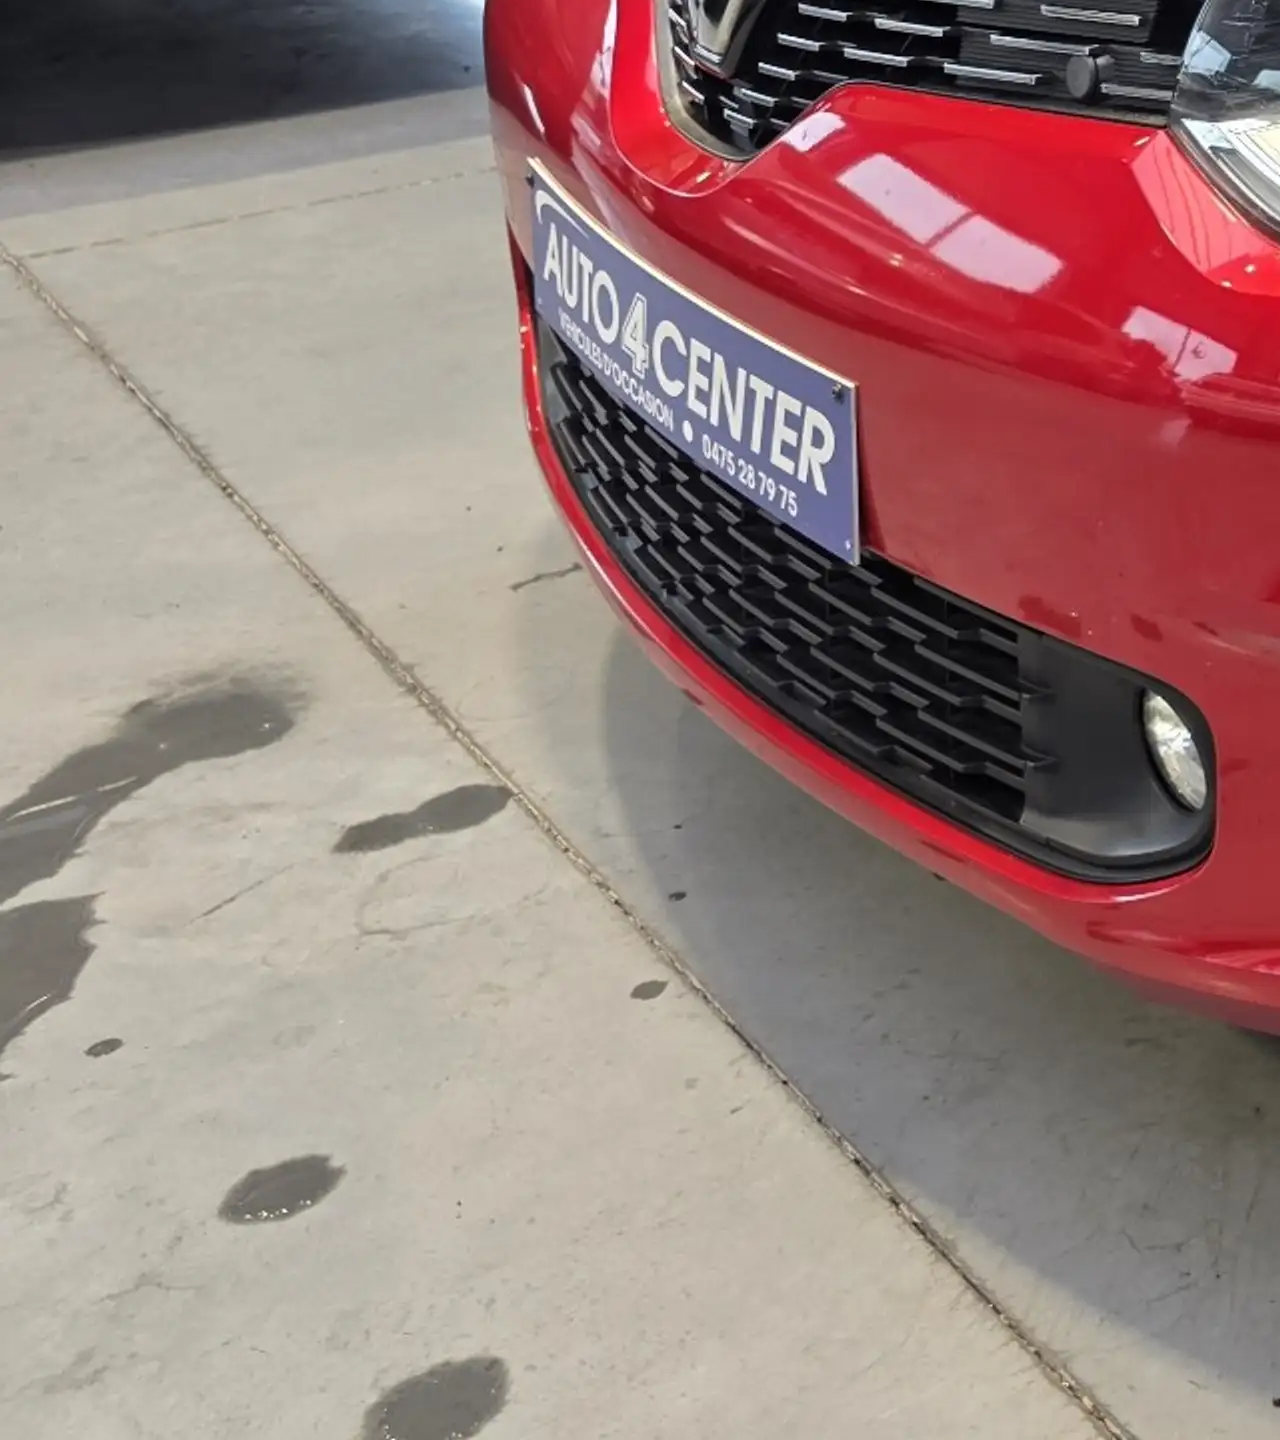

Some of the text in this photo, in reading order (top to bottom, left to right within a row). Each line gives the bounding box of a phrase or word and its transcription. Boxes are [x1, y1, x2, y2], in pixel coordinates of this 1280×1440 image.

[702, 433, 735, 477] 0475
[738, 458, 755, 490] 28
[758, 471, 776, 501] 79
[779, 486, 798, 518] 75
